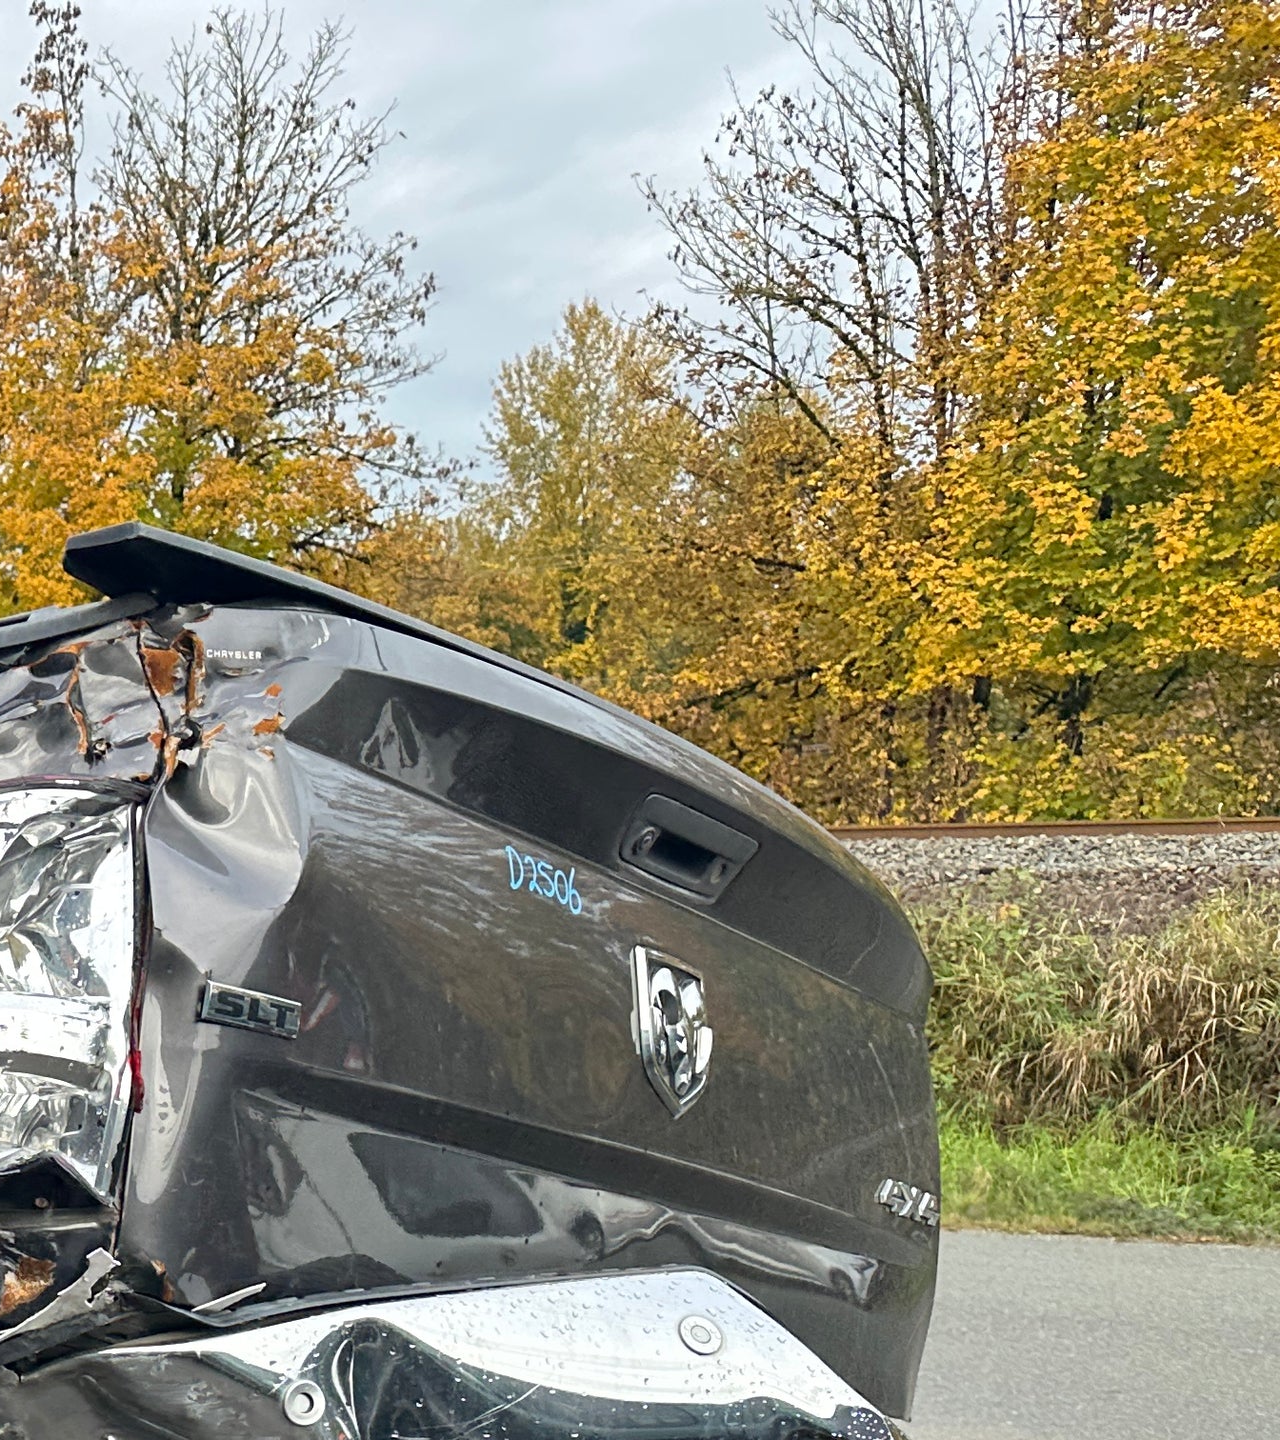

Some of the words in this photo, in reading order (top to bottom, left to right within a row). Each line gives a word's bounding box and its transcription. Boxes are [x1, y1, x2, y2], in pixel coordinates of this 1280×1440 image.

[206, 648, 262, 660] CHRYSLER
[505, 845, 583, 915] D2506
[214, 990, 296, 1030] SLT
